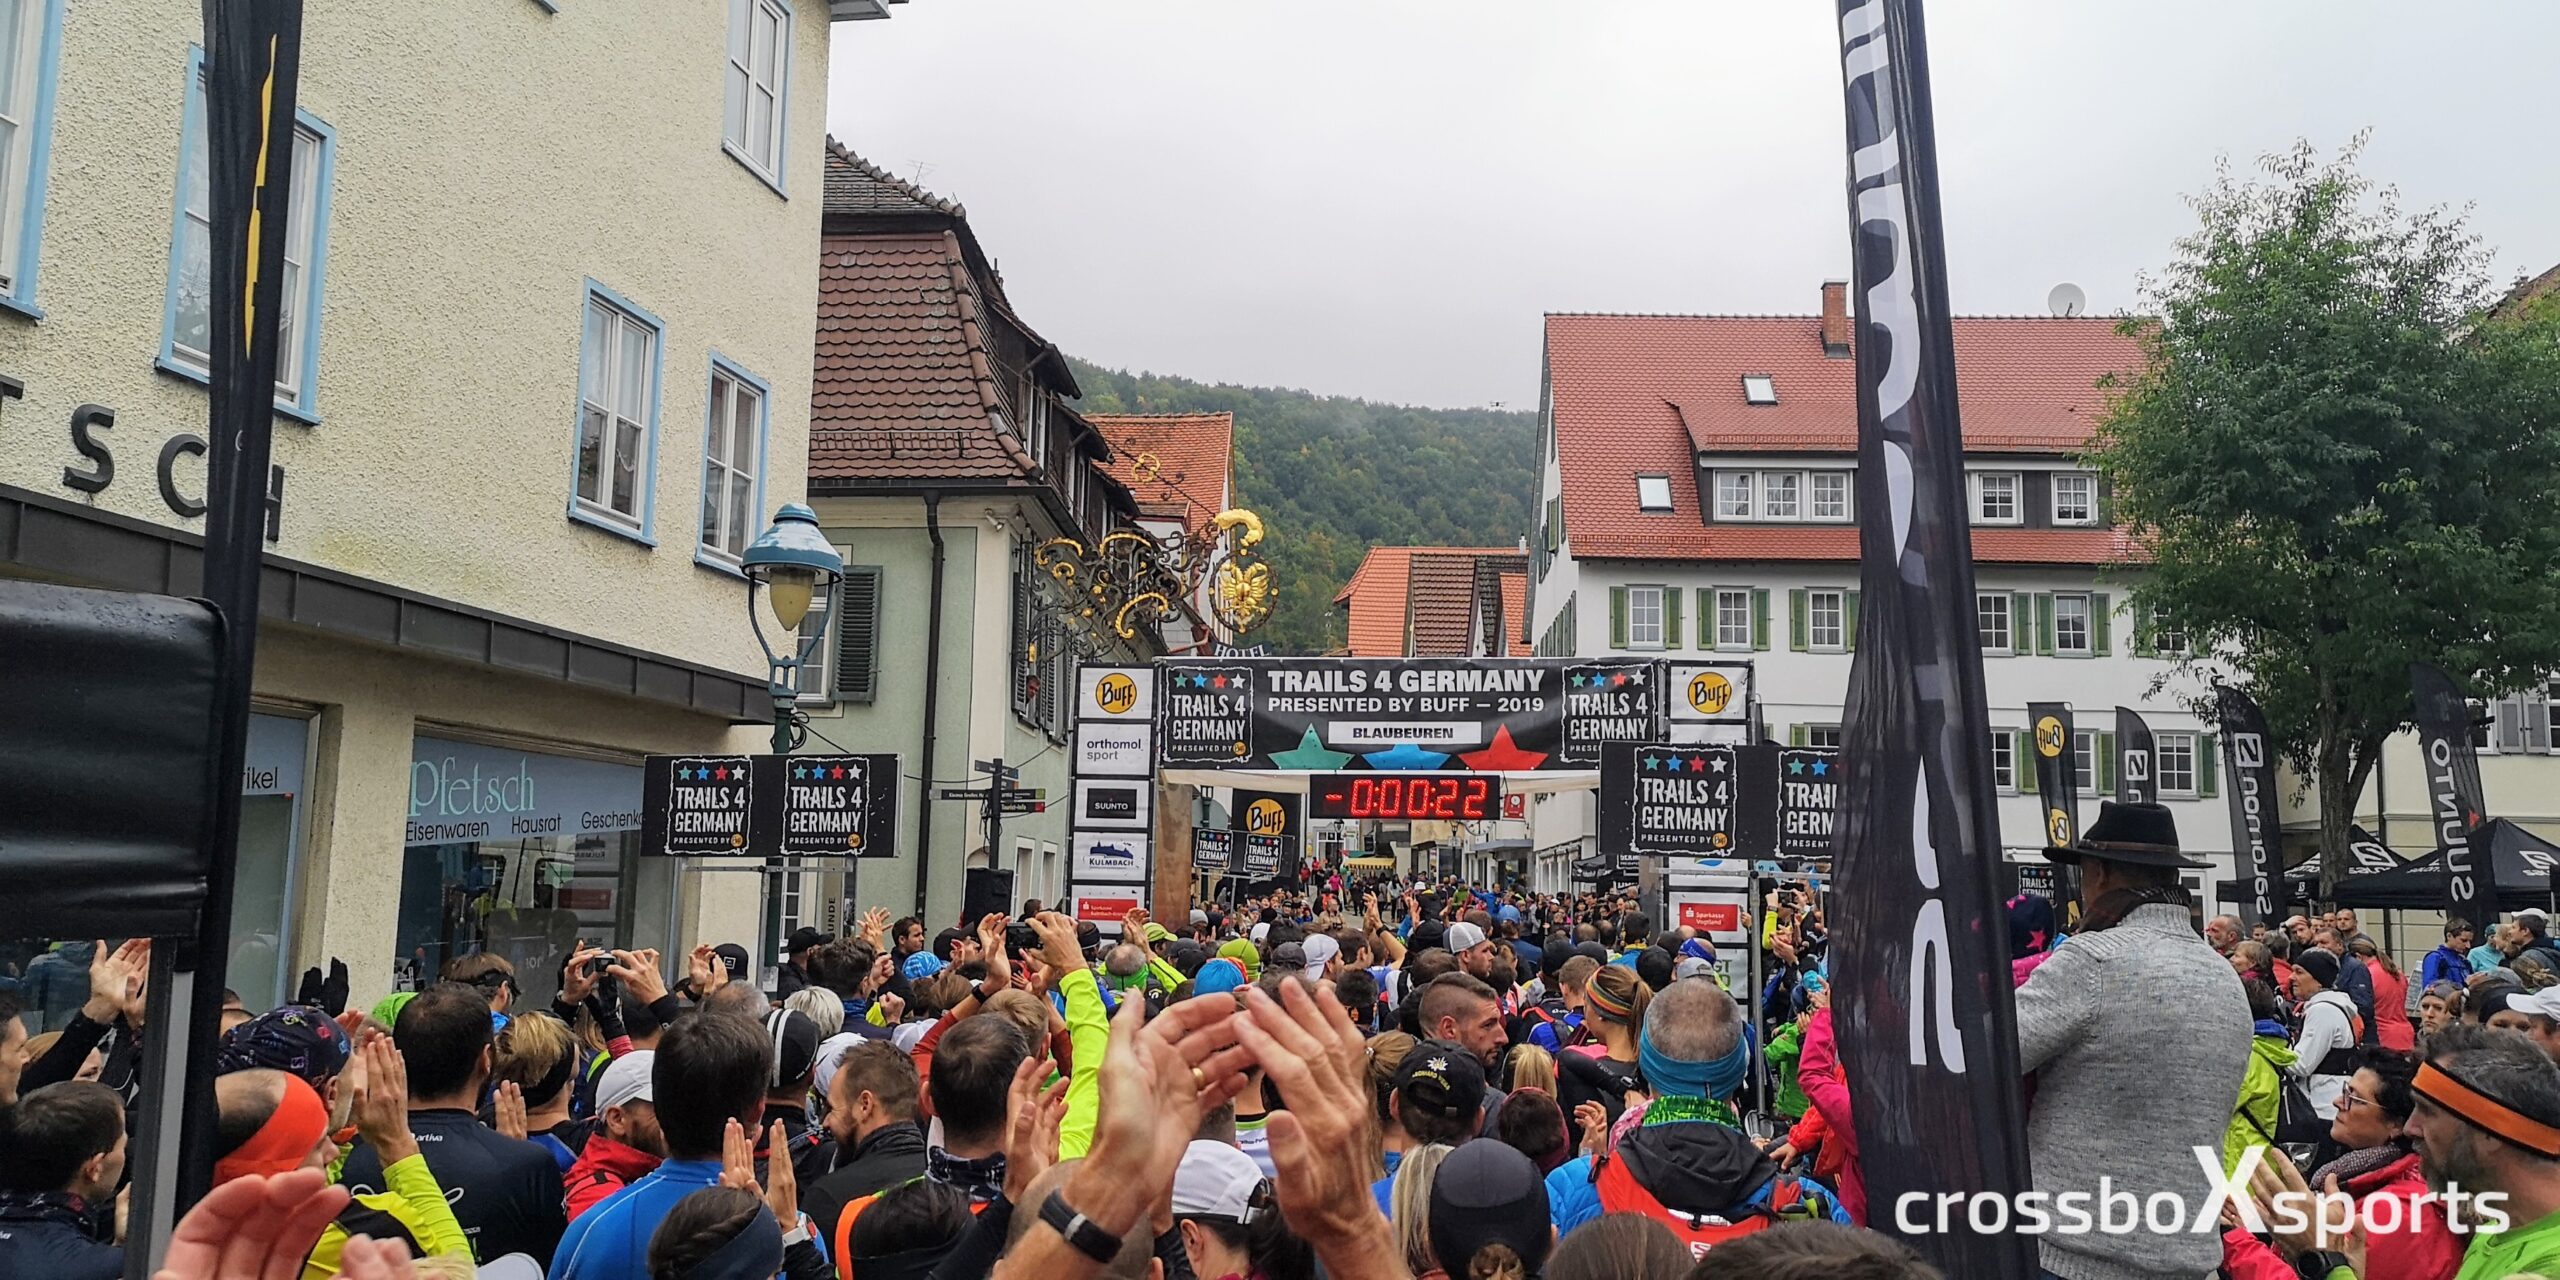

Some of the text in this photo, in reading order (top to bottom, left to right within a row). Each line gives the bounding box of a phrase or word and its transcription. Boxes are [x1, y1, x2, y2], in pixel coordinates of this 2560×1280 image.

[1214, 643, 1272, 657] HOTEL
[1267, 669, 1546, 693] TRAILS 4 GERMANY
[1172, 694, 1246, 717] TRAILS 4
[1268, 697, 1383, 713] PRESENTED
[1388, 697, 1414, 713] BY
[1420, 697, 1470, 713] BUFF
[1497, 697, 1544, 713] 2019
[1569, 692, 1648, 716] TRAILS 4
[1172, 719, 1246, 741] GERMANY
[1352, 727, 1454, 739] BLAUBEUREN
[1569, 717, 1648, 741] GERMANY
[1086, 738, 1142, 749] orthomol
[1172, 744, 1220, 752] PRESENTED
[1570, 744, 1600, 752] PRESE
[1086, 750, 1118, 762] sport
[243, 766, 278, 789] ikel
[407, 756, 537, 817] Pfetsch
[1640, 777, 1729, 806] TRAILS 4
[675, 786, 746, 809] TRAILS 4
[790, 786, 863, 809] TRAILS 4
[1094, 802, 1129, 810] SUUNTO
[674, 811, 745, 833] GERMANY
[790, 811, 862, 833] GERMANY
[1641, 806, 1729, 831] GERMANY
[1786, 811, 1835, 836] GERM
[405, 820, 490, 842] Eisenwaren
[511, 813, 562, 835] Hausrat
[673, 836, 717, 845] PRESENTED
[789, 836, 836, 845] PRESENTED
[1199, 840, 1223, 851] TRAILS
[1641, 833, 1697, 843] PRESENTED
[1786, 838, 1831, 849] PRESENT
[1248, 845, 1272, 856] TRAILS
[1089, 858, 1134, 867] KULMBACH
[2021, 877, 2048, 889] TRAILS
